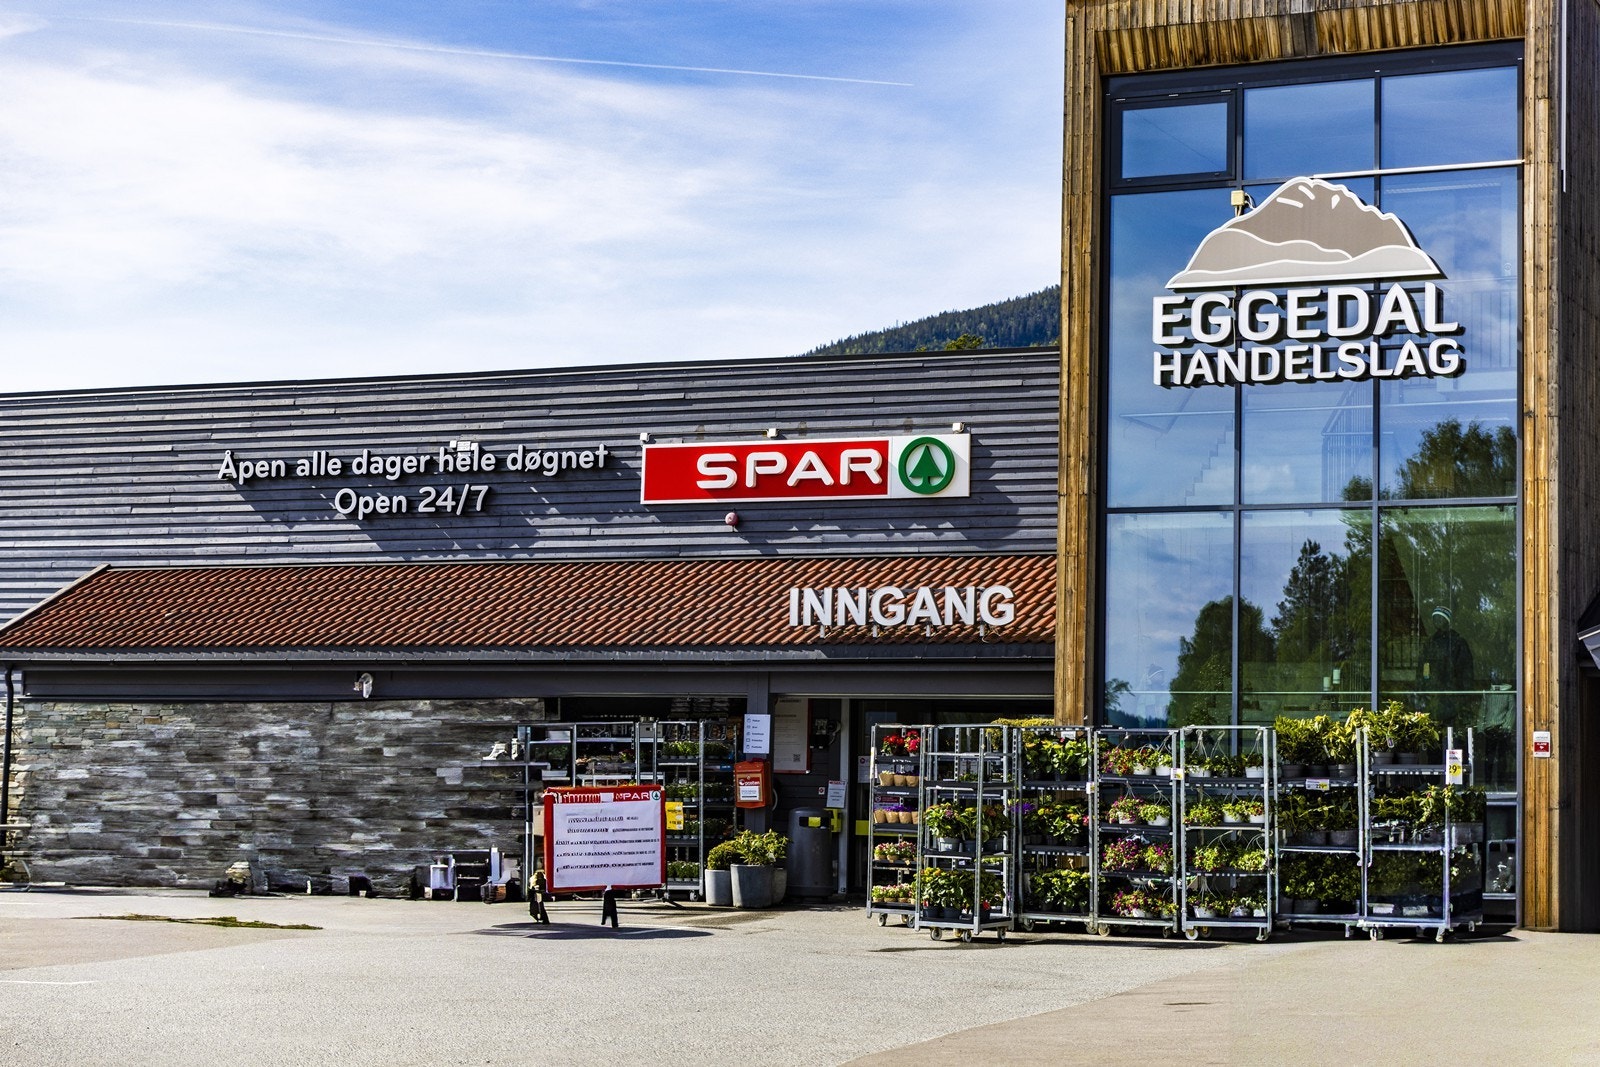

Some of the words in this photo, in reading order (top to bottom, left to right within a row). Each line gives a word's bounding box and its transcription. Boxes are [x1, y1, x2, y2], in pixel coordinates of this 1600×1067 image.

[1152, 282, 1460, 345] EGGEDAL
[1153, 338, 1462, 386] HANDELSLAG
[218, 449, 286, 485] Åpen
[296, 450, 342, 477] alle
[352, 449, 431, 481] dager
[438, 446, 496, 473] hele
[507, 443, 609, 477] døgnet
[696, 448, 883, 490] SPAR
[334, 488, 407, 520] Open
[418, 484, 489, 515] 24/7
[789, 584, 1016, 627] INNGANG
